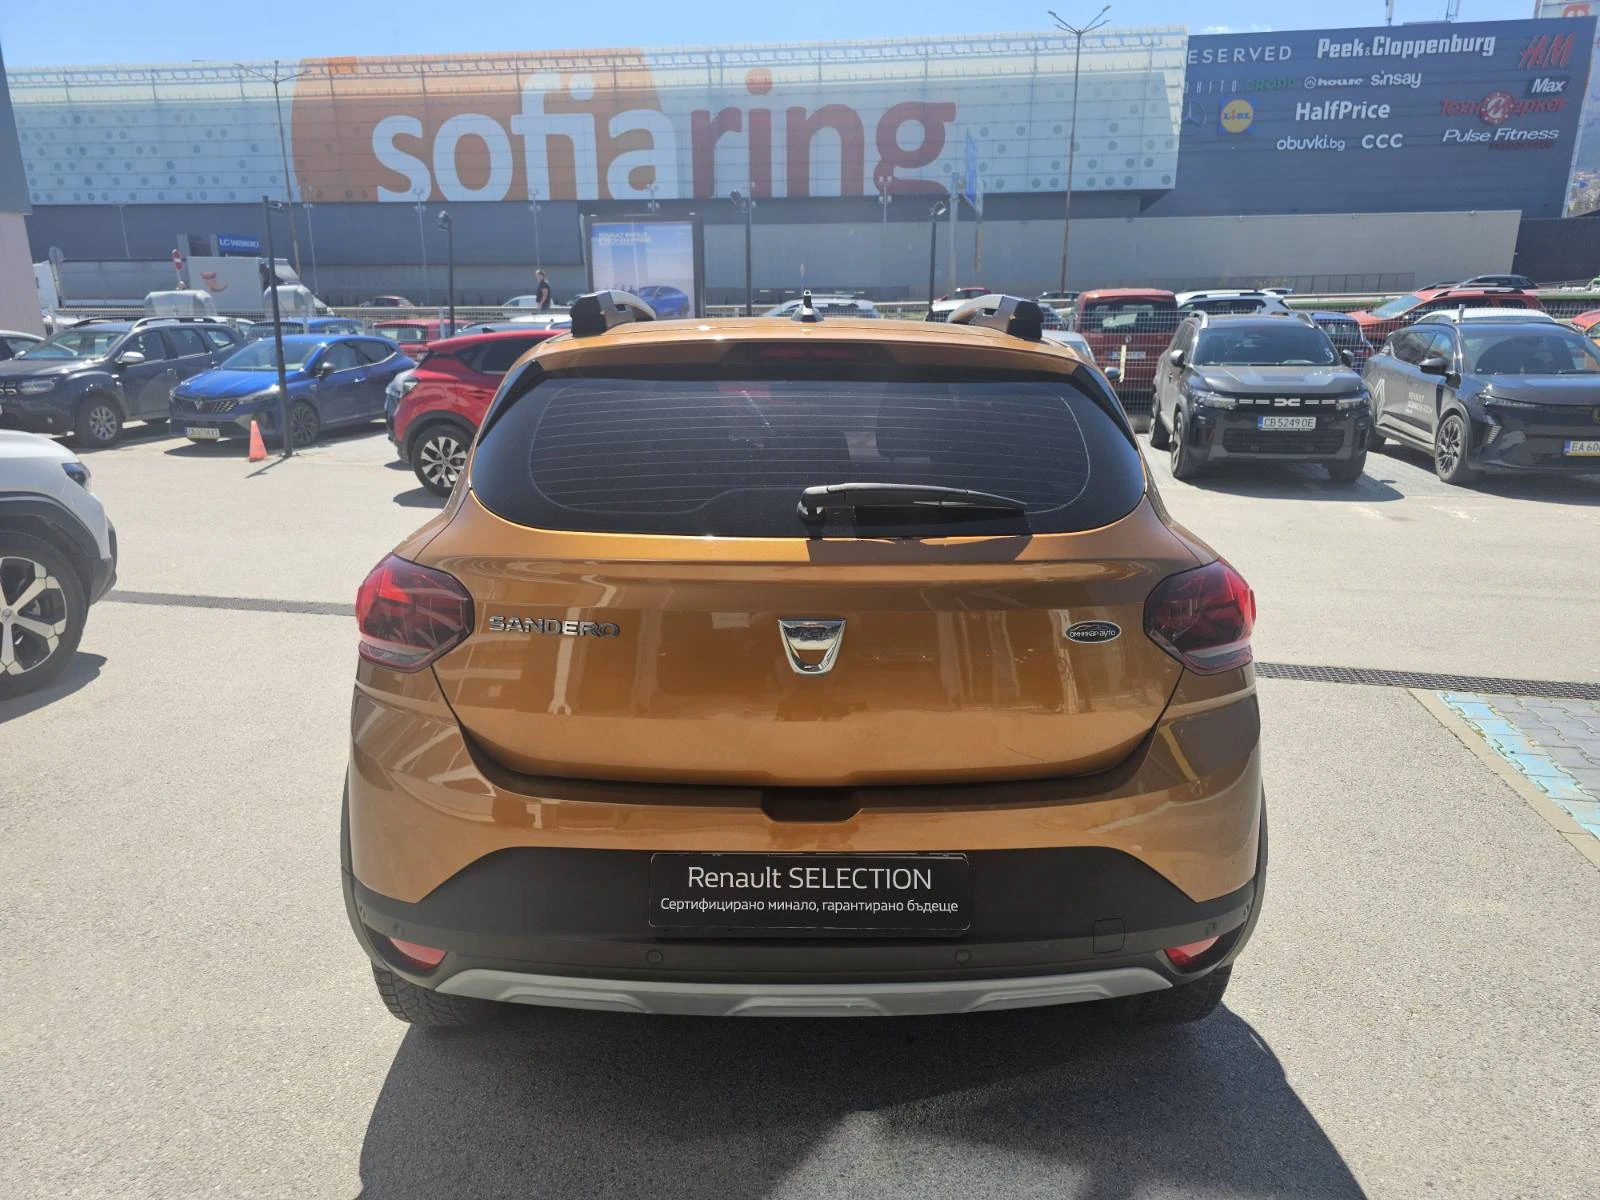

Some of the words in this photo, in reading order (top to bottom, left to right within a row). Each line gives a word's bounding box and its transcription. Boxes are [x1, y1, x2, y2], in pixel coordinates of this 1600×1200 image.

[1370, 70, 1422, 89] sinsay
[1531, 78, 1567, 93] Max
[1295, 100, 1391, 121] HalfPrice
[1276, 134, 1346, 151] obuvki.bg
[1361, 133, 1404, 149] CCC
[1442, 128, 1491, 143] Pulse
[1493, 126, 1560, 142] Fitness
[488, 614, 621, 637] SANDERO
[688, 866, 782, 889] Renault
[788, 867, 932, 890] SELECTION
[660, 897, 765, 913] Сертифицирано
[767, 900, 820, 913] минало,
[822, 901, 904, 914] гарантирано
[906, 899, 959, 914] бъдеще
